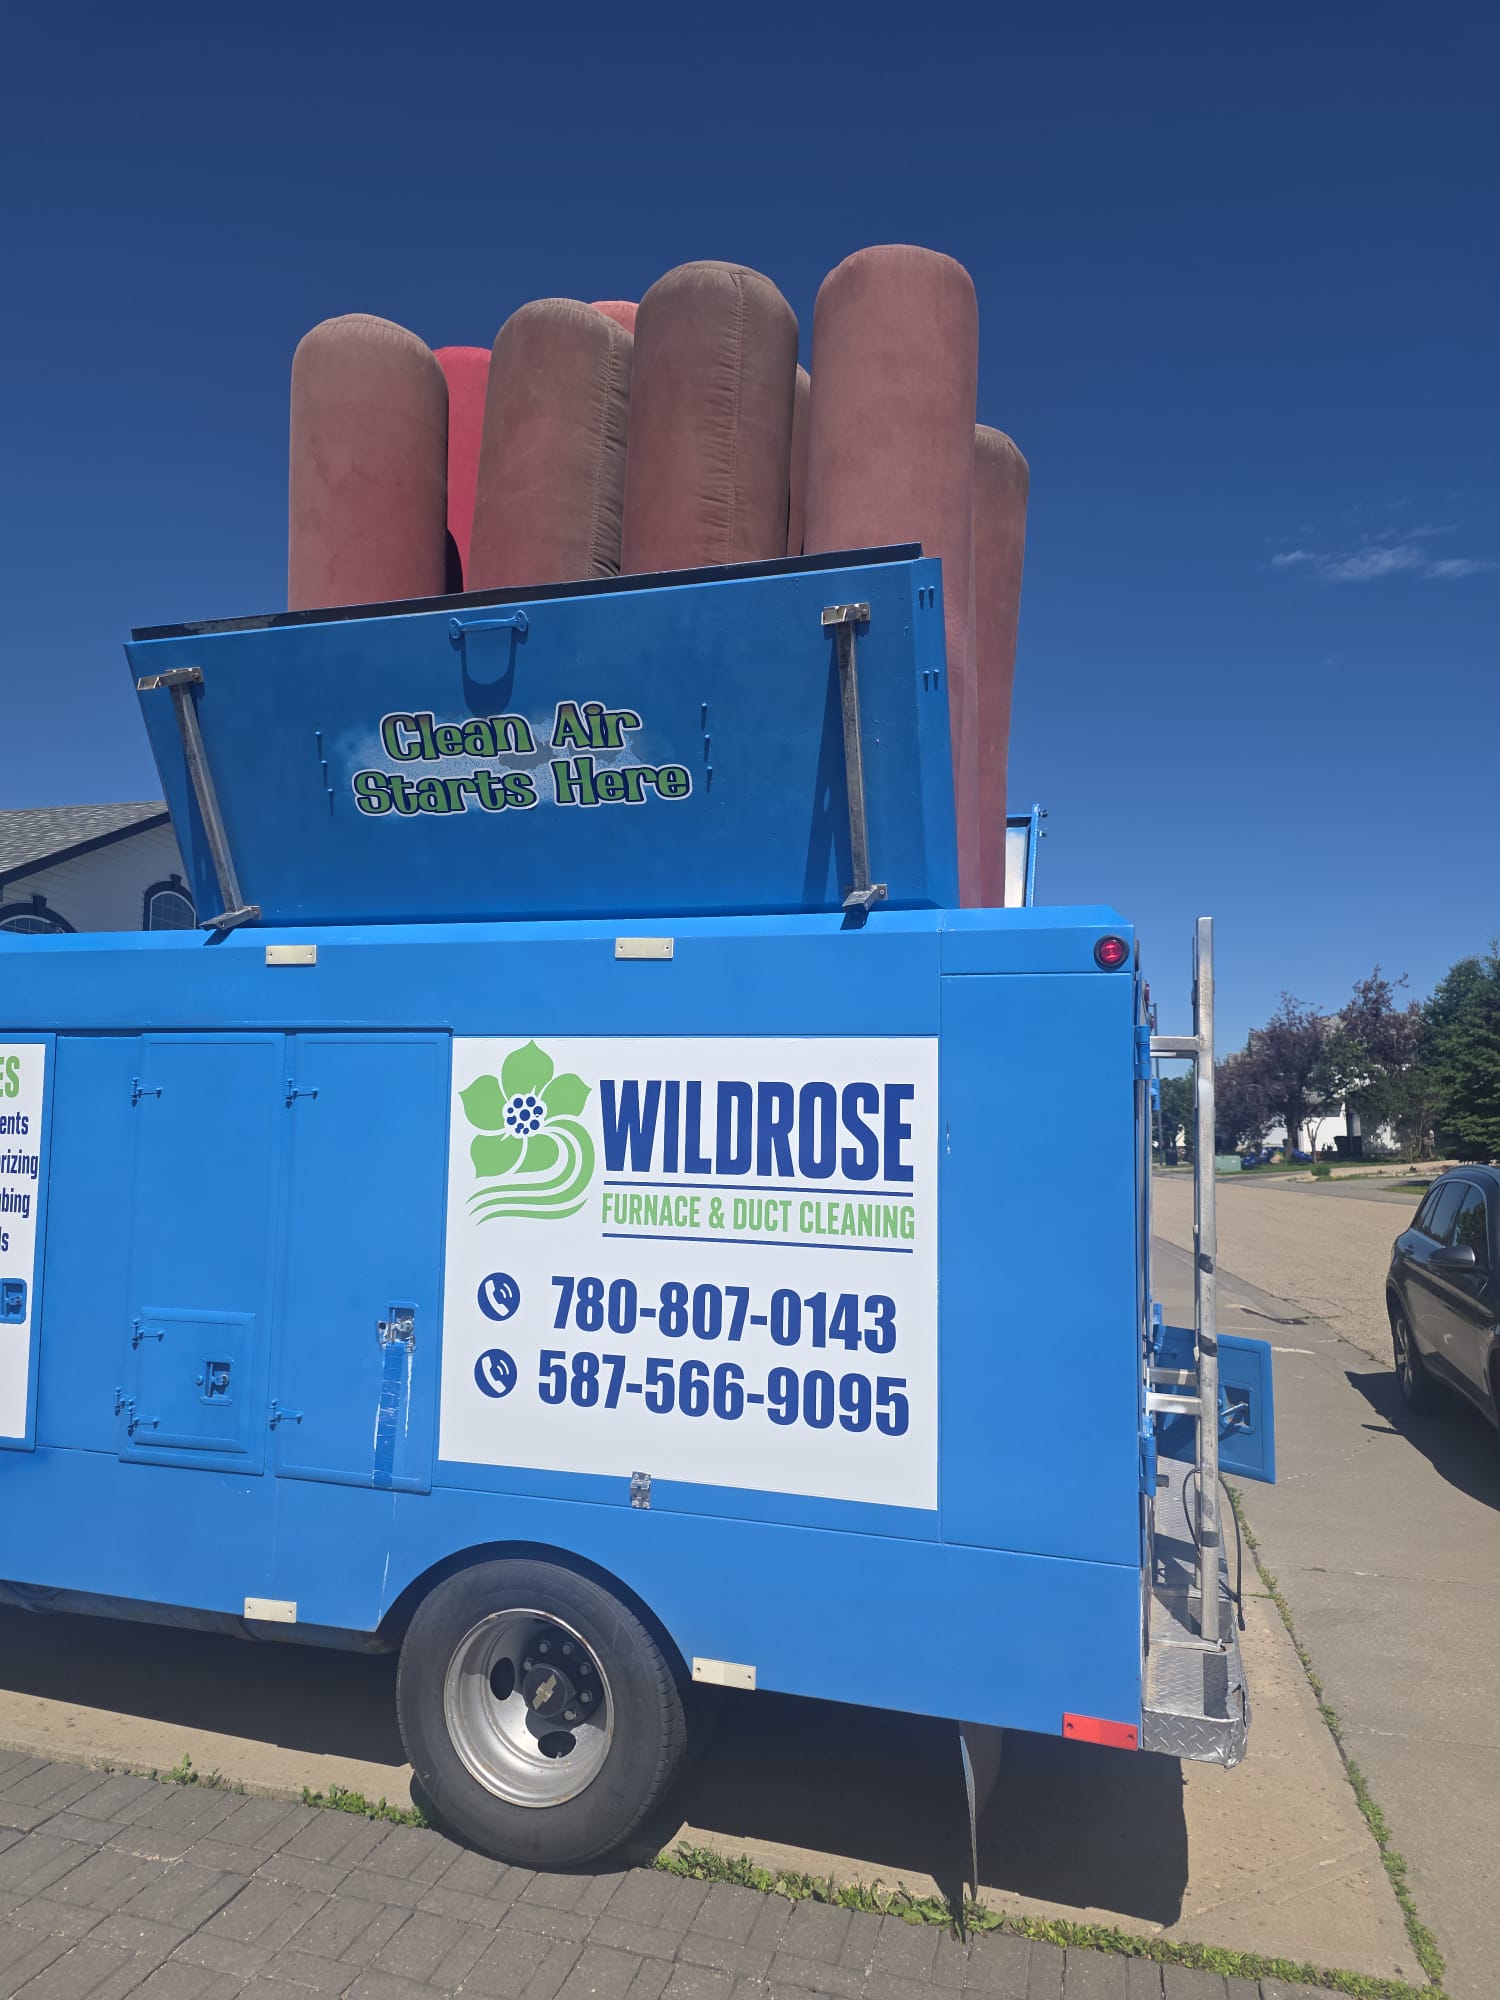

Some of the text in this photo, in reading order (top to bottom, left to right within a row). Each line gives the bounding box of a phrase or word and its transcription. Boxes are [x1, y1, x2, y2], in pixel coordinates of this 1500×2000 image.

[381, 700, 641, 761] Clean Air
[353, 754, 692, 816] Starts Here
[0, 1112, 29, 1135] ents
[600, 1080, 914, 1182] WILDROSE
[0, 1187, 30, 1218] bing
[602, 1193, 914, 1239] FURNACE & DUCT CLEANING
[552, 1276, 896, 1354] 780-807-0143
[539, 1349, 909, 1436] 587-566-9095
